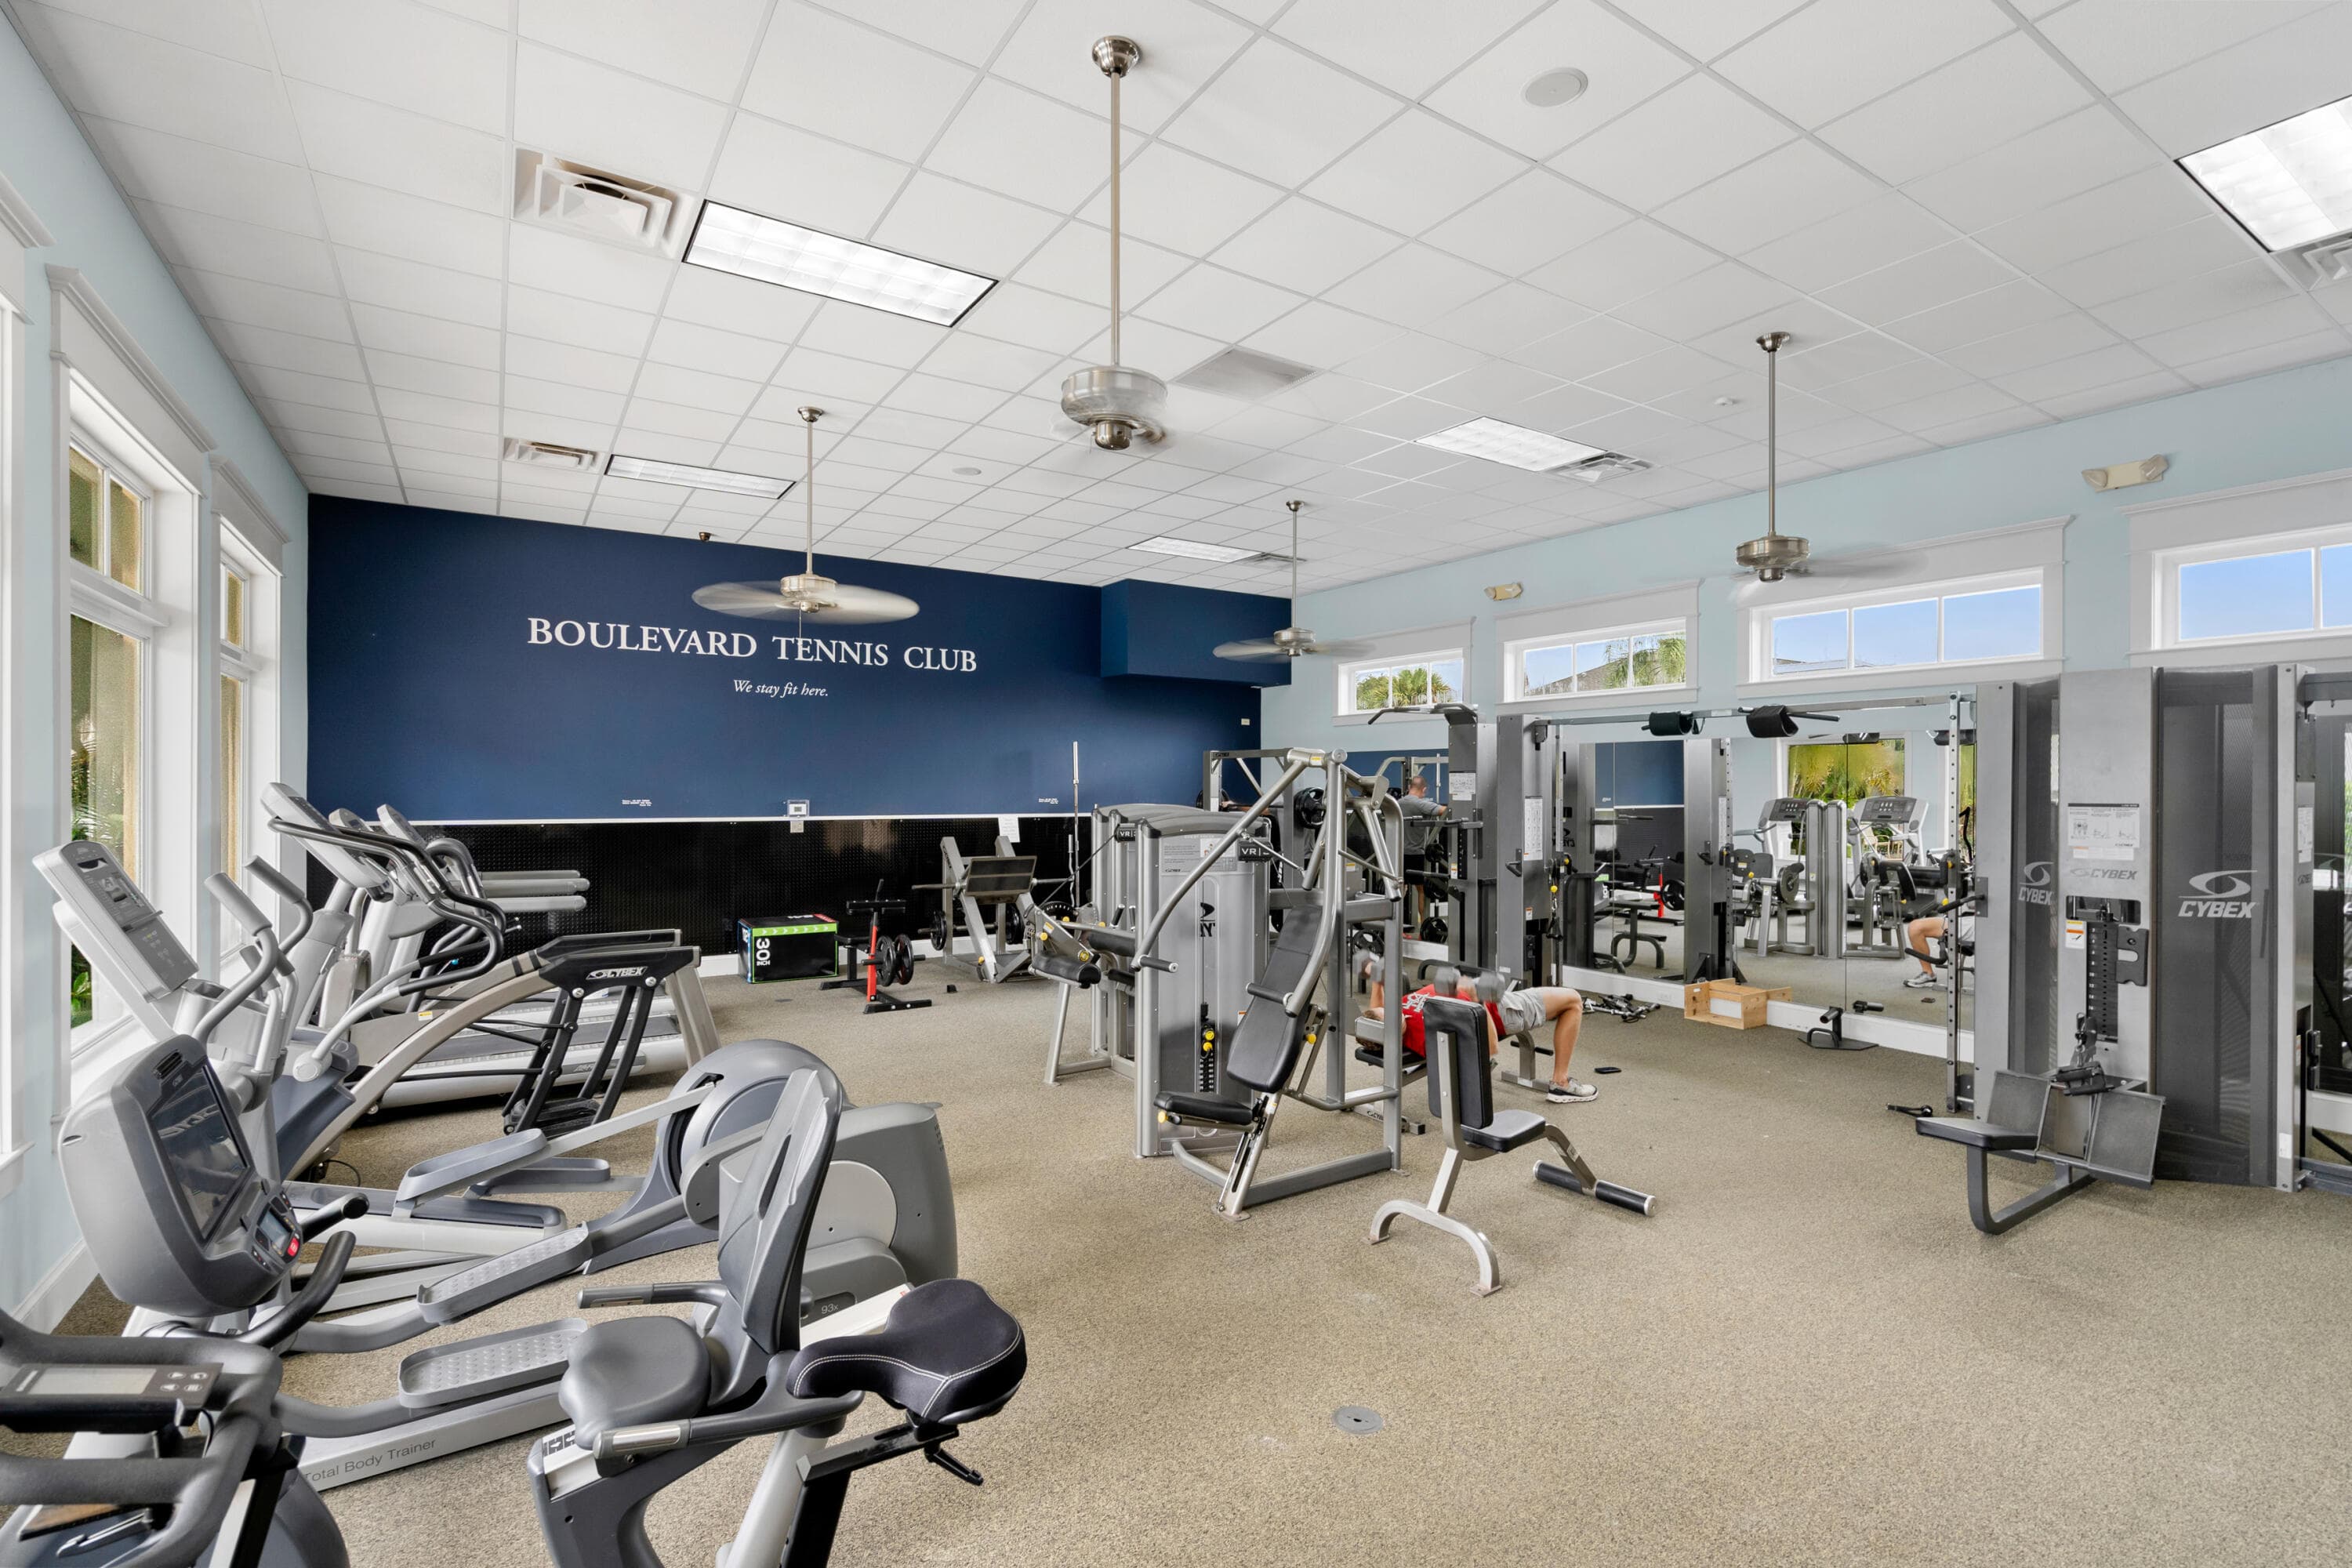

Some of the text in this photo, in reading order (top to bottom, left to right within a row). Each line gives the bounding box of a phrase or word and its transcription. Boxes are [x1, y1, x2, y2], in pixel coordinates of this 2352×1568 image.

[527, 617, 978, 672] BOULEVARD TENNIS CLUB
[733, 679, 829, 699] We stay fit here.
[2090, 868, 2139, 880] CYBEX
[2018, 886, 2053, 906] CYBEX
[2178, 900, 2257, 919] CYBEX
[756, 938, 771, 960] 30
[344, 1454, 383, 1473] Body
[387, 1439, 436, 1461] Trainer
